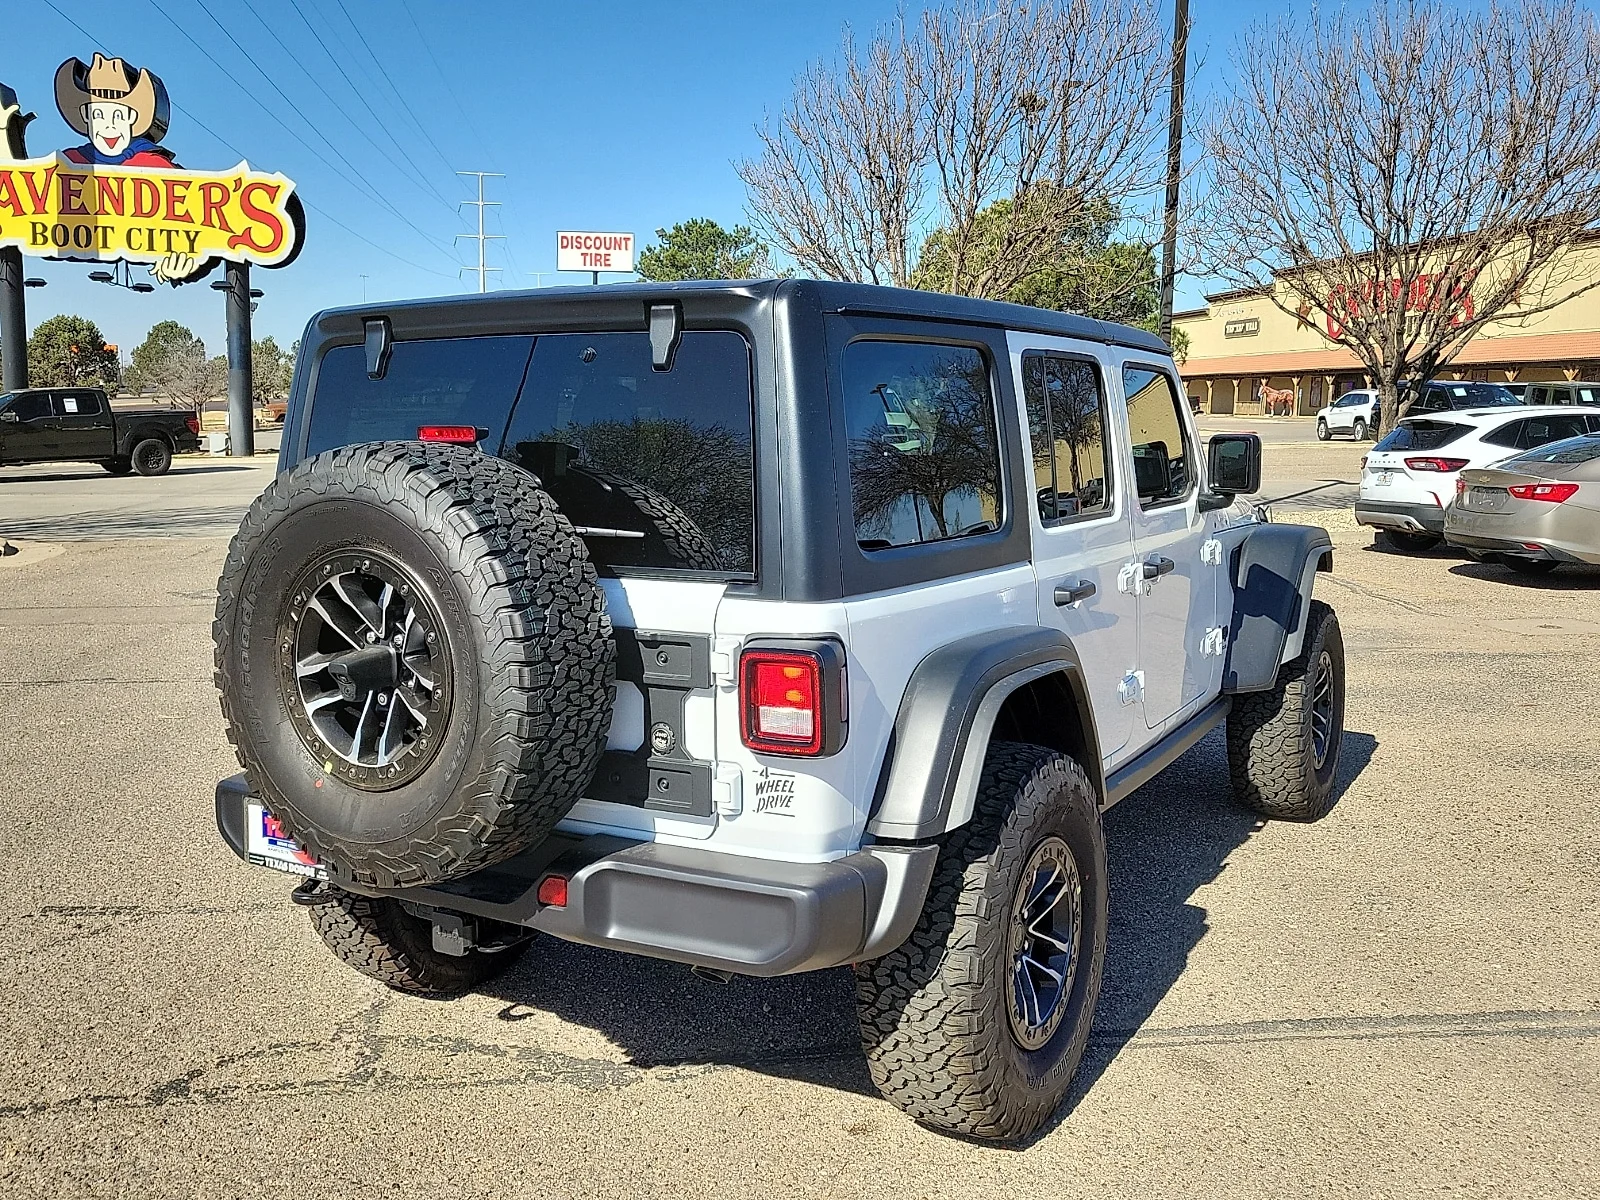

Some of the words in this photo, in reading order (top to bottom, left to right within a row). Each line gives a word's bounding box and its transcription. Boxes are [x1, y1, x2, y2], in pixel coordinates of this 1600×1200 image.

[0, 163, 283, 253] AVENDER'S
[29, 221, 115, 249] BOOT
[126, 226, 202, 253] CITY
[560, 235, 631, 251] DISCOUNT
[580, 252, 612, 267] TIRE
[756, 779, 795, 796] WHEEL
[756, 794, 795, 814] DRIVE
